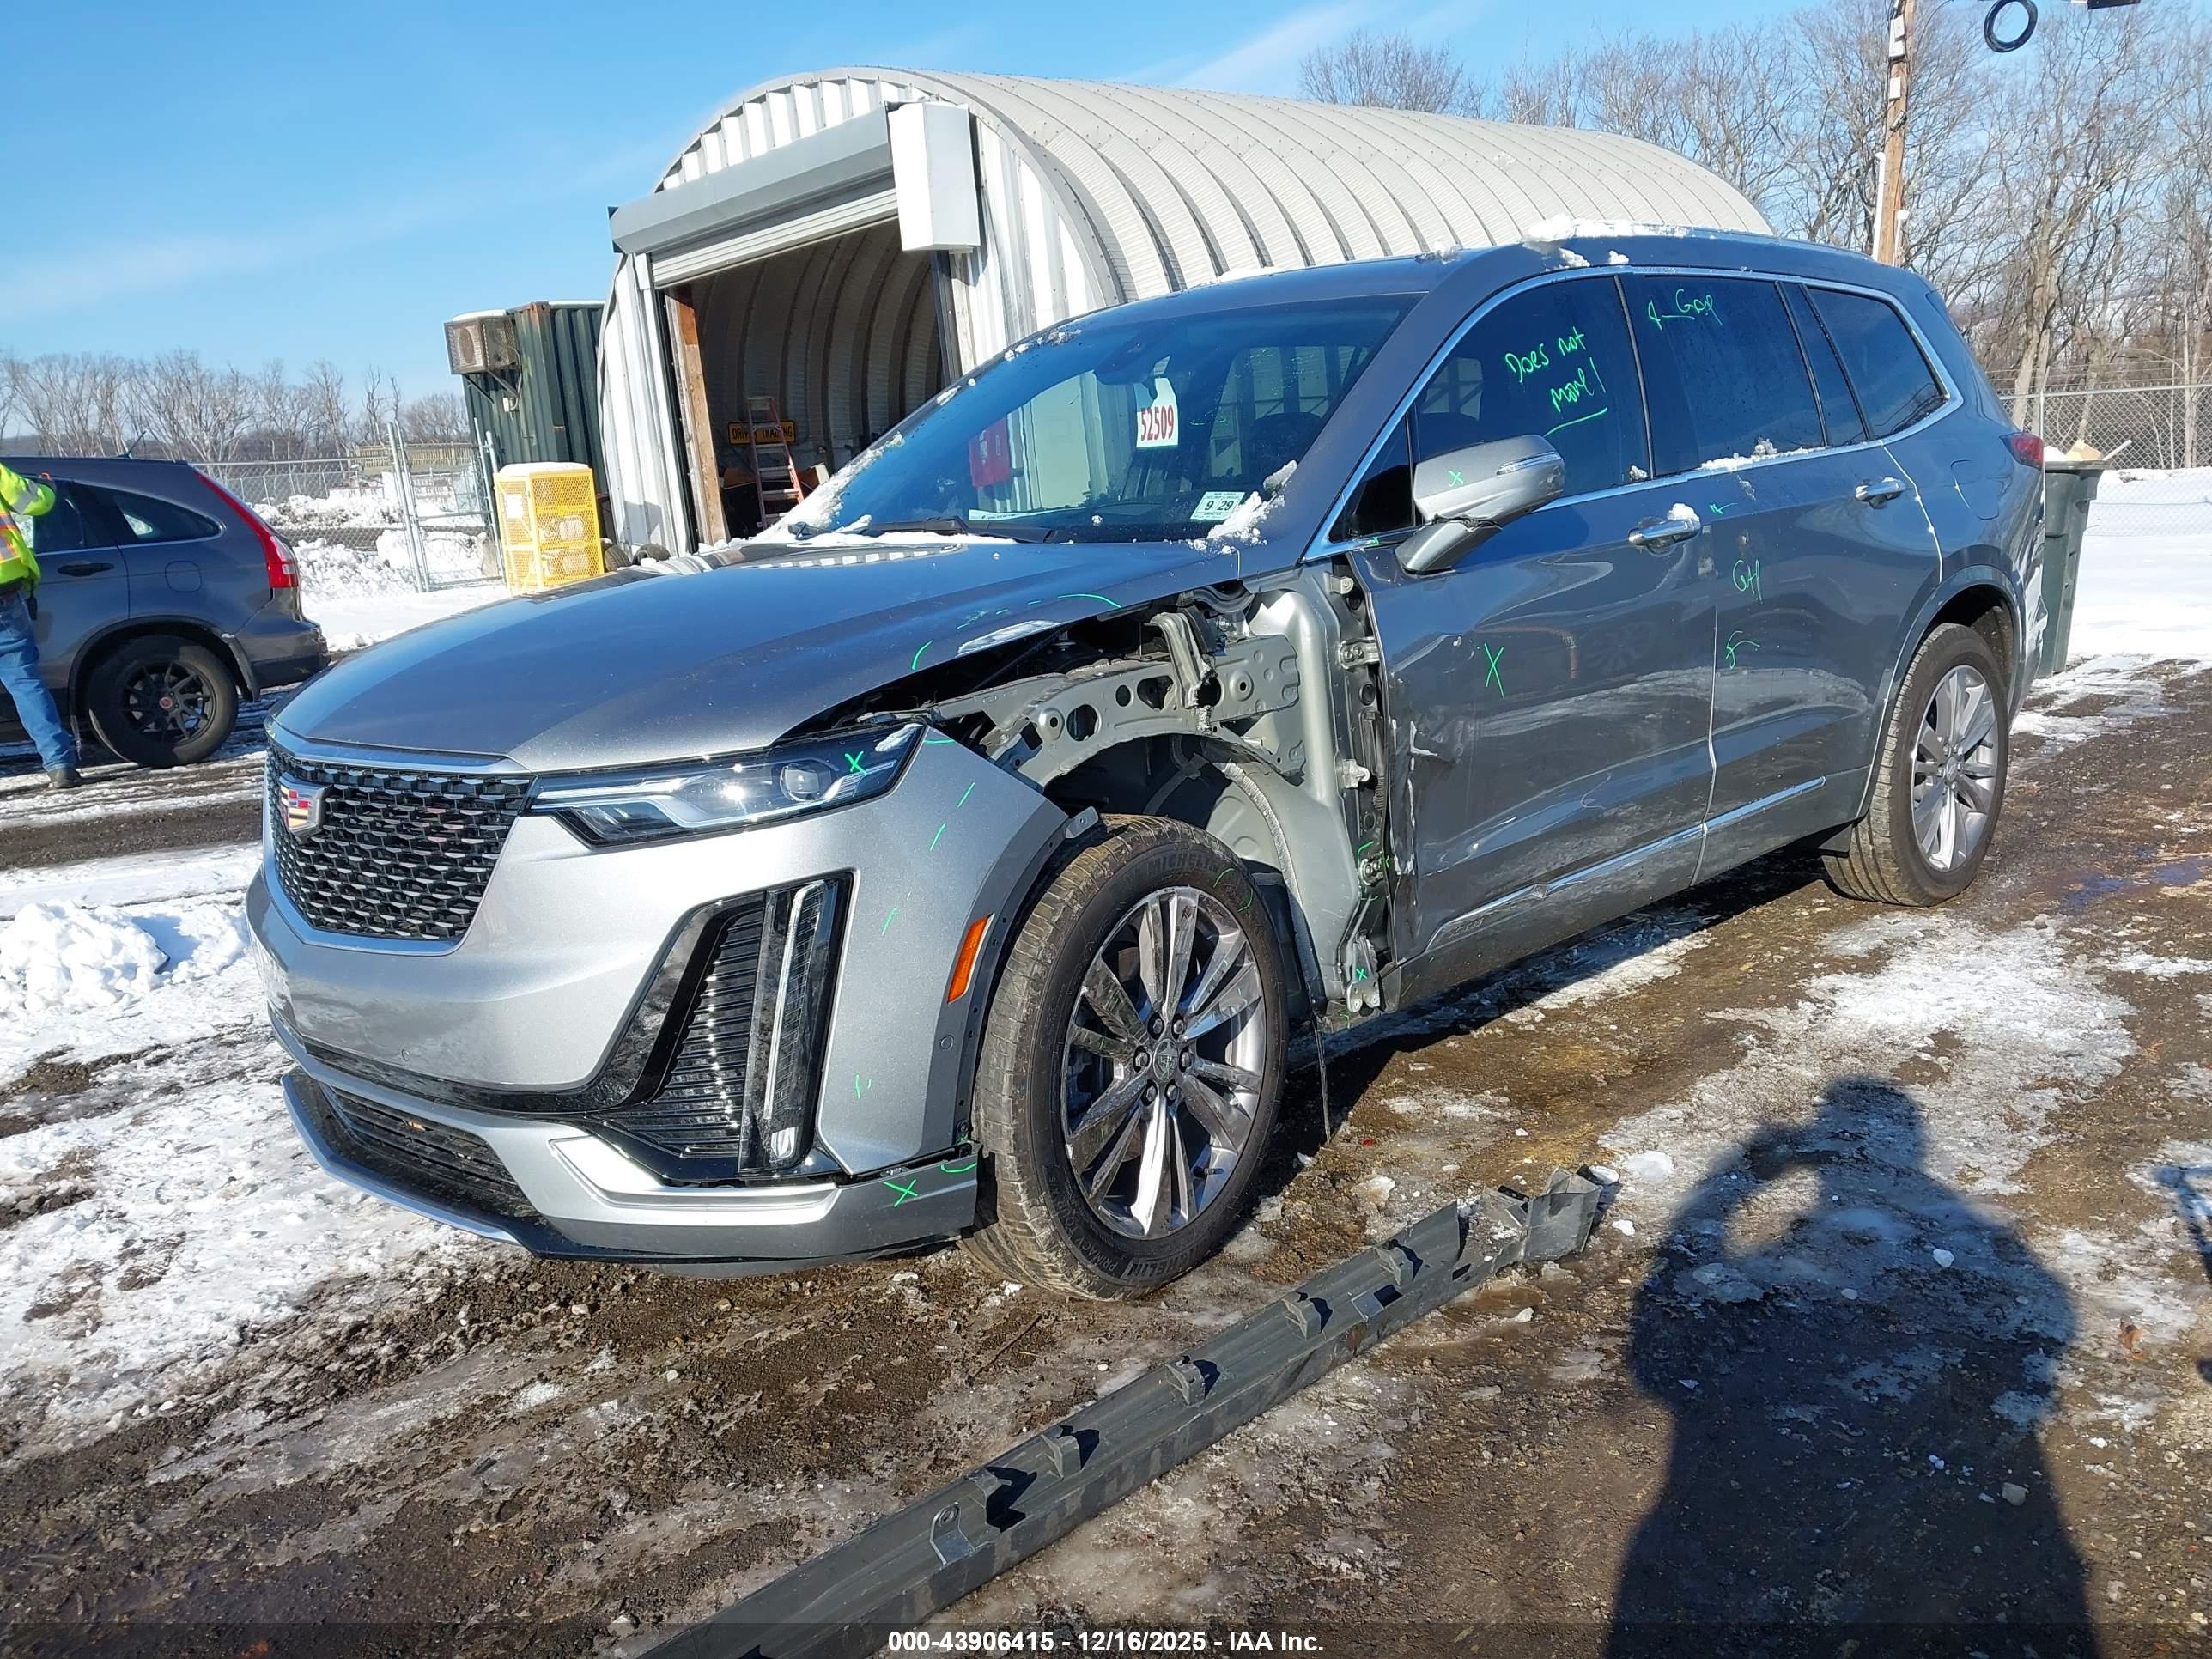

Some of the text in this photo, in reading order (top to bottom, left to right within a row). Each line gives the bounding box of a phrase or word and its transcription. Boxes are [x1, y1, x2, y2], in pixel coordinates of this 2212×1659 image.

[1505, 326, 1586, 384] Does not
[1140, 405, 1174, 441] 52509
[1205, 501, 1234, 511] 9 29
[1076, 1237, 1119, 1273] PRIMACY
